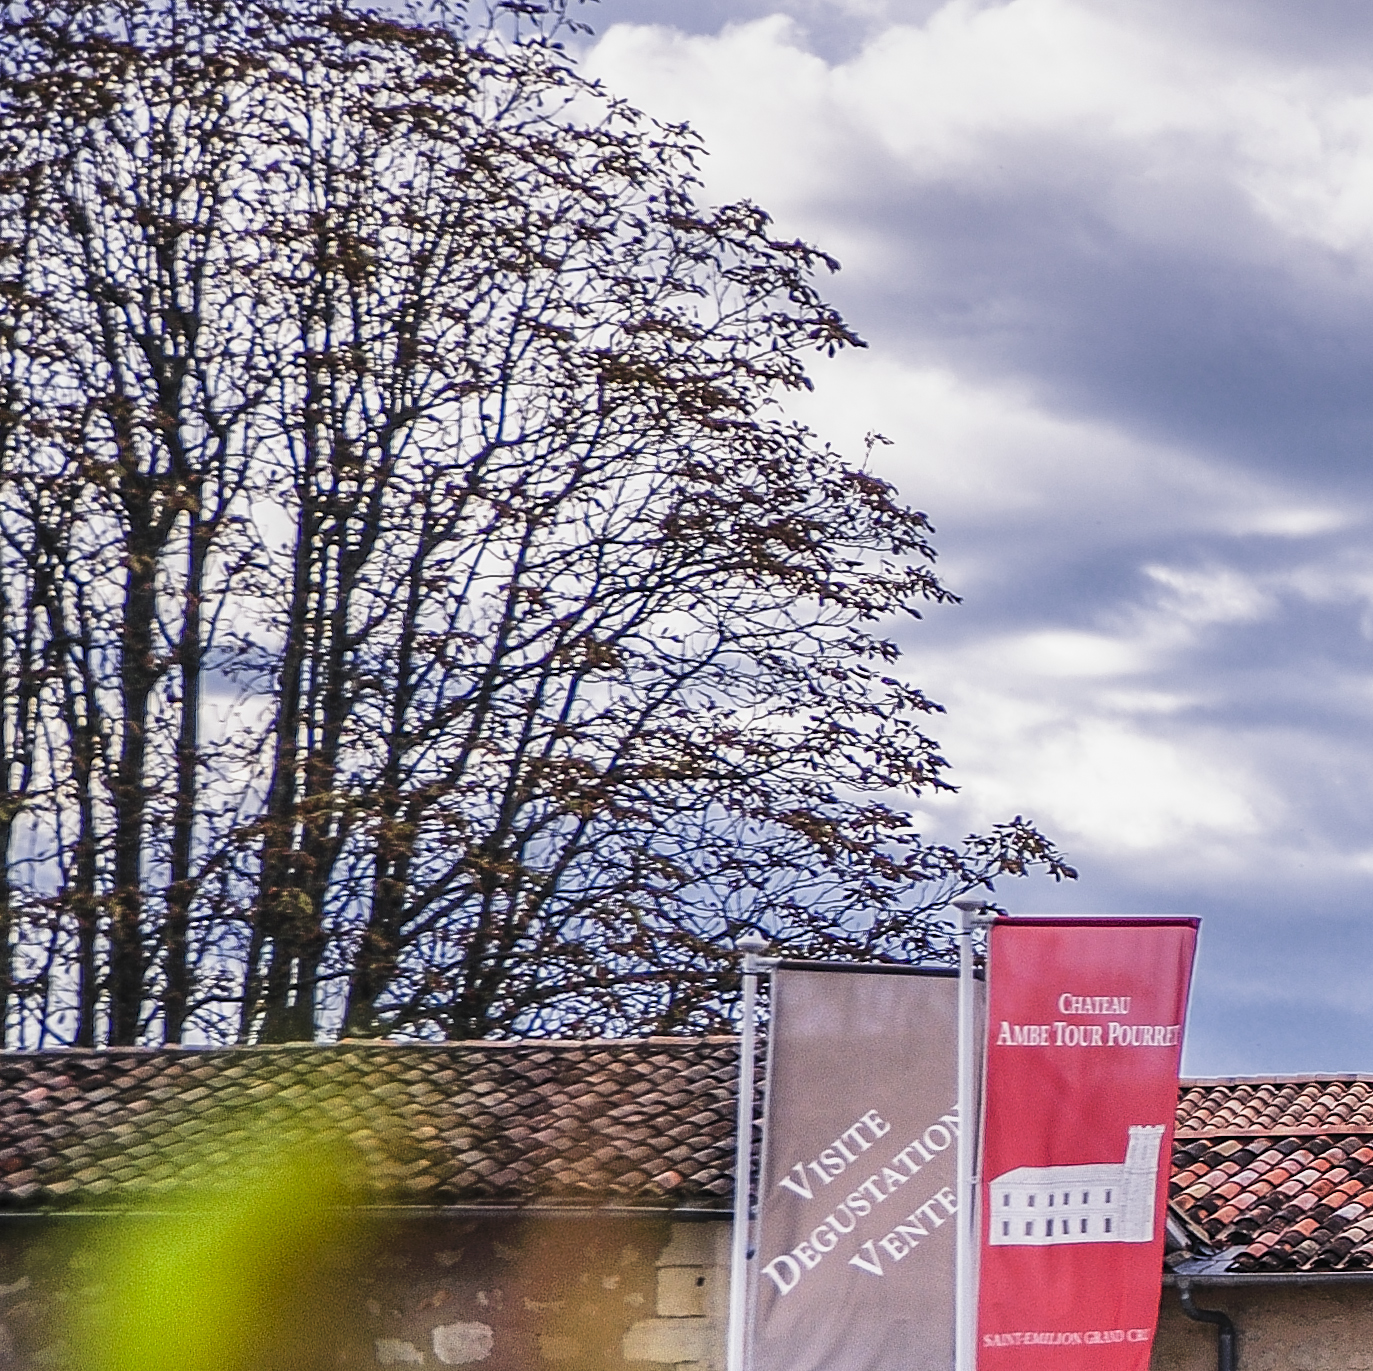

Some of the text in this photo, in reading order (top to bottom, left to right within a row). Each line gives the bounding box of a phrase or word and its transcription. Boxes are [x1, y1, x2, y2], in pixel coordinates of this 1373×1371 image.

[996, 1020, 1051, 1046] AMBE
[1053, 1021, 1103, 1047] TOUR
[1058, 993, 1131, 1015] CHATEAU
[778, 1108, 891, 1200] VISITE
[761, 1103, 961, 1297] DEGUSTATION
[848, 1186, 959, 1277] VENTE
